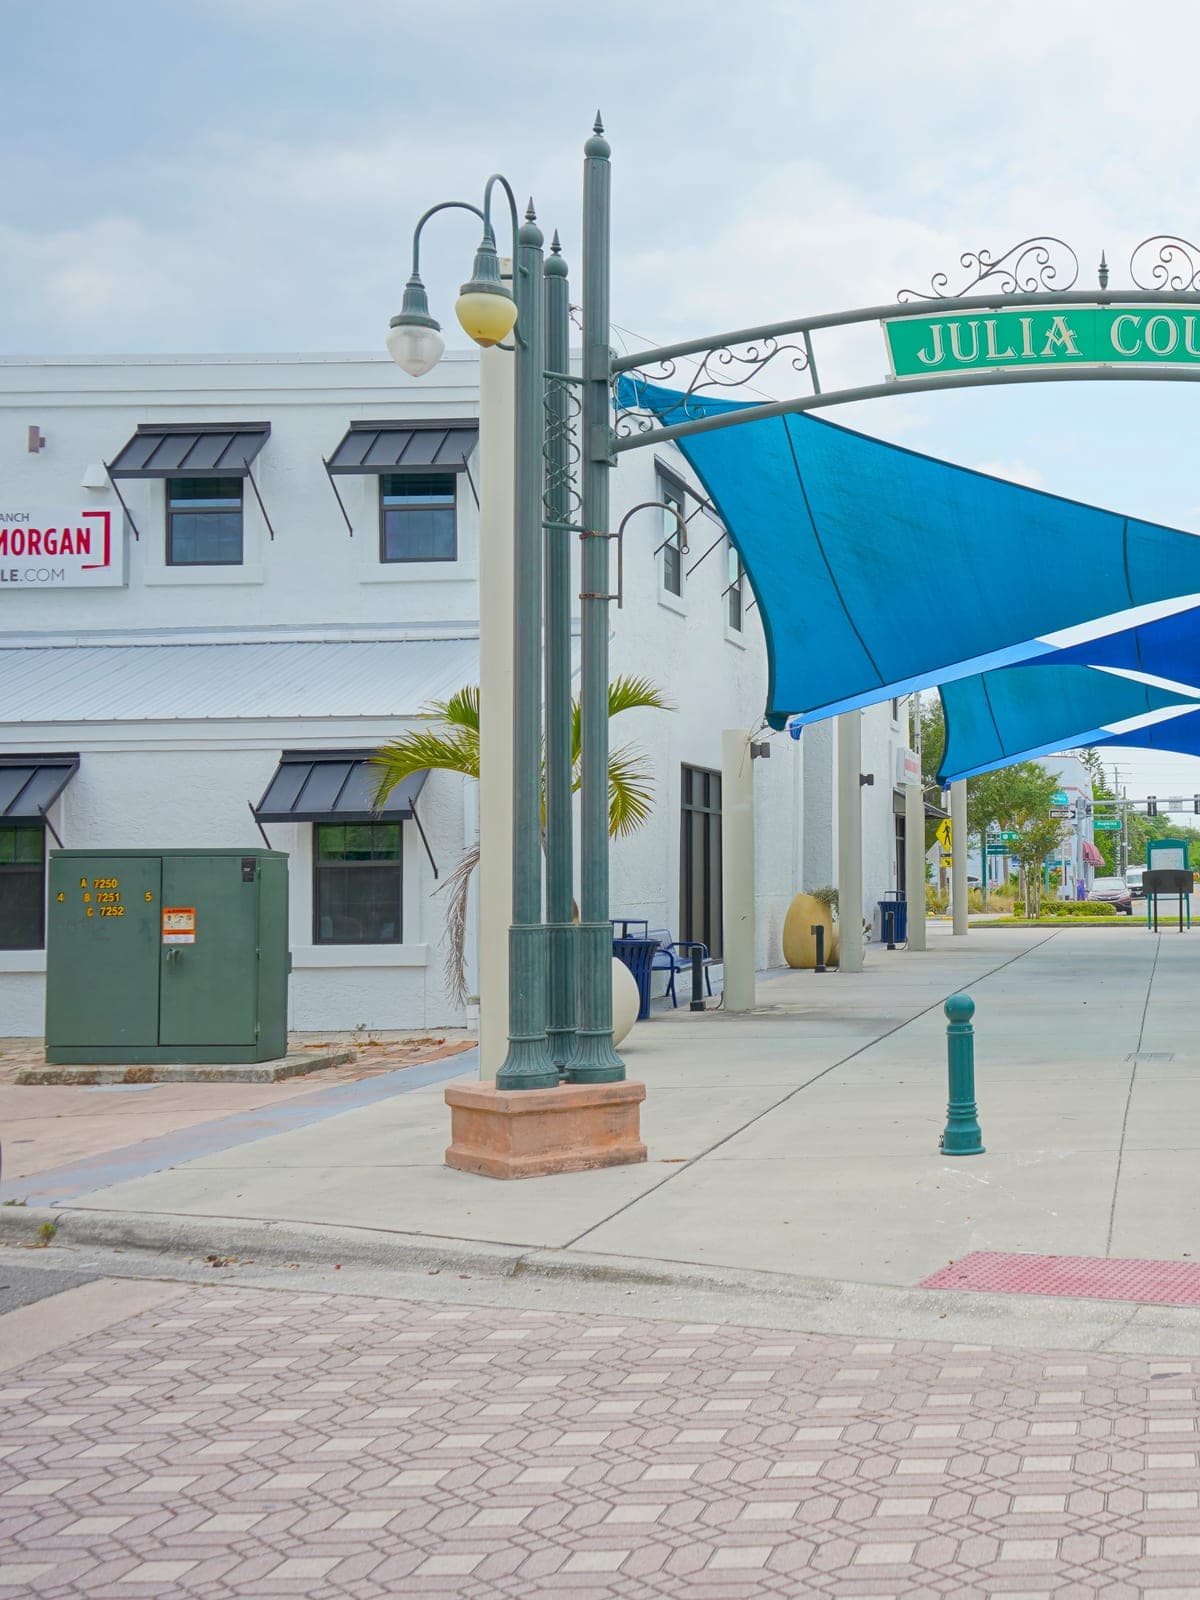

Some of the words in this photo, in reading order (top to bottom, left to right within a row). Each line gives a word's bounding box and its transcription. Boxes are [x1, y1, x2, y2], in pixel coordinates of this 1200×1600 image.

[917, 316, 1083, 366] JULIA
[80, 878, 87, 888] A
[94, 879, 118, 889] 7250
[57, 892, 65, 902] 4
[97, 892, 120, 902] 7251
[145, 891, 153, 902] 5
[100, 906, 124, 917] 7252
